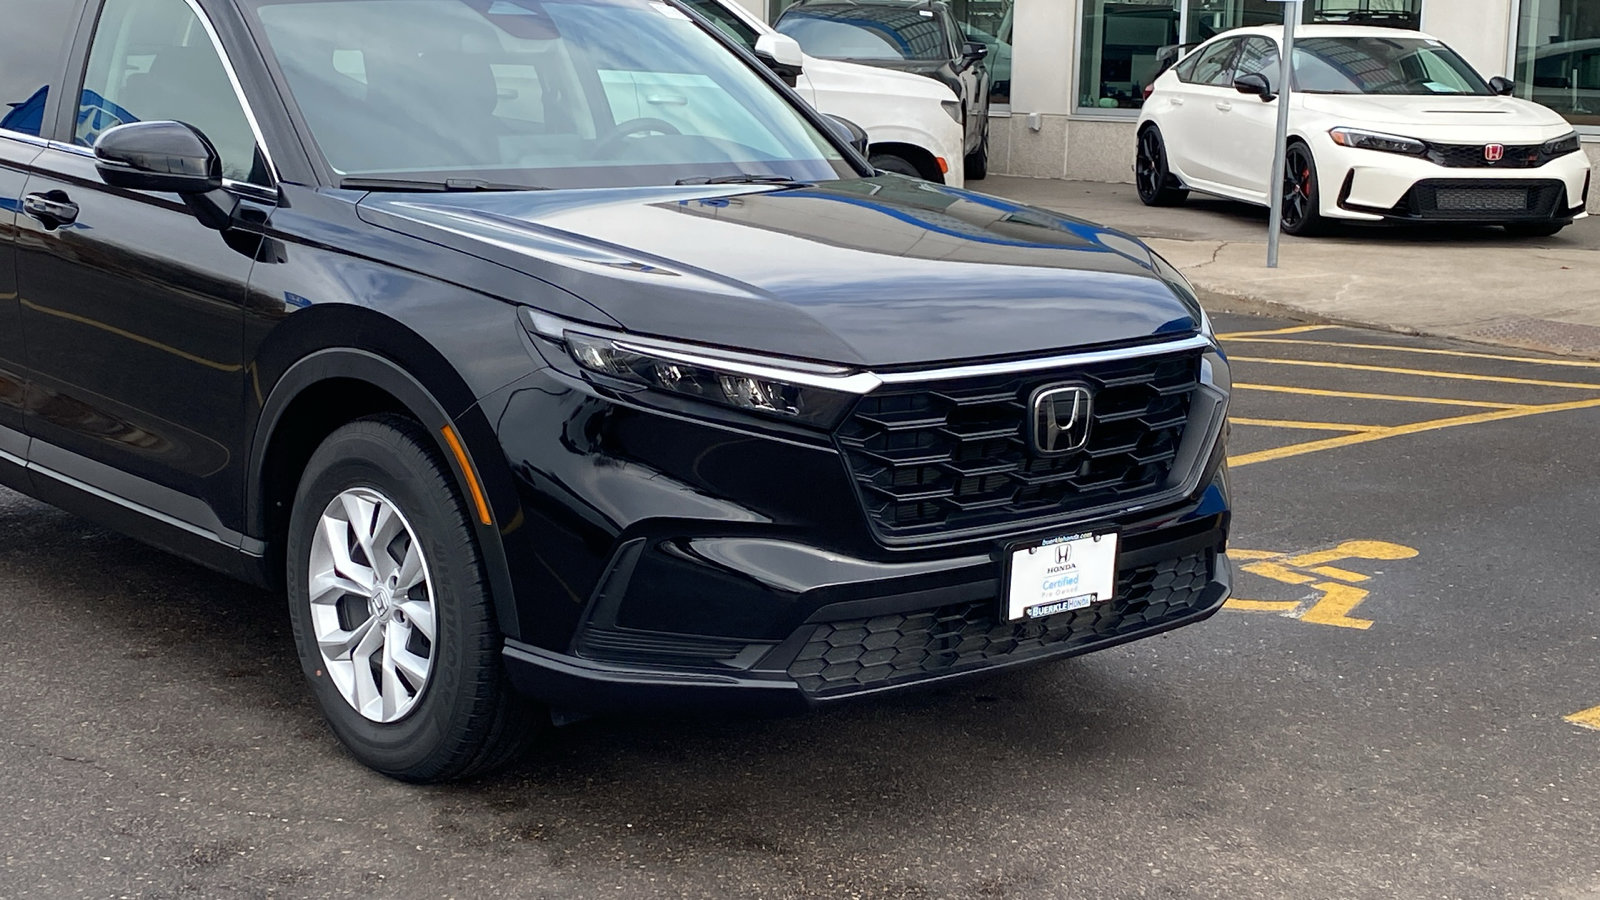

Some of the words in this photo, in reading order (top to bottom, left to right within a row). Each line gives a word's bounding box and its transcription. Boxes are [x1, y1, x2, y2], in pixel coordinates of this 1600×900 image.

[1047, 563, 1076, 574] HONDA
[1042, 574, 1079, 590] Certified
[1031, 601, 1068, 616] BUERKLE
[1069, 597, 1089, 609] HONDA
